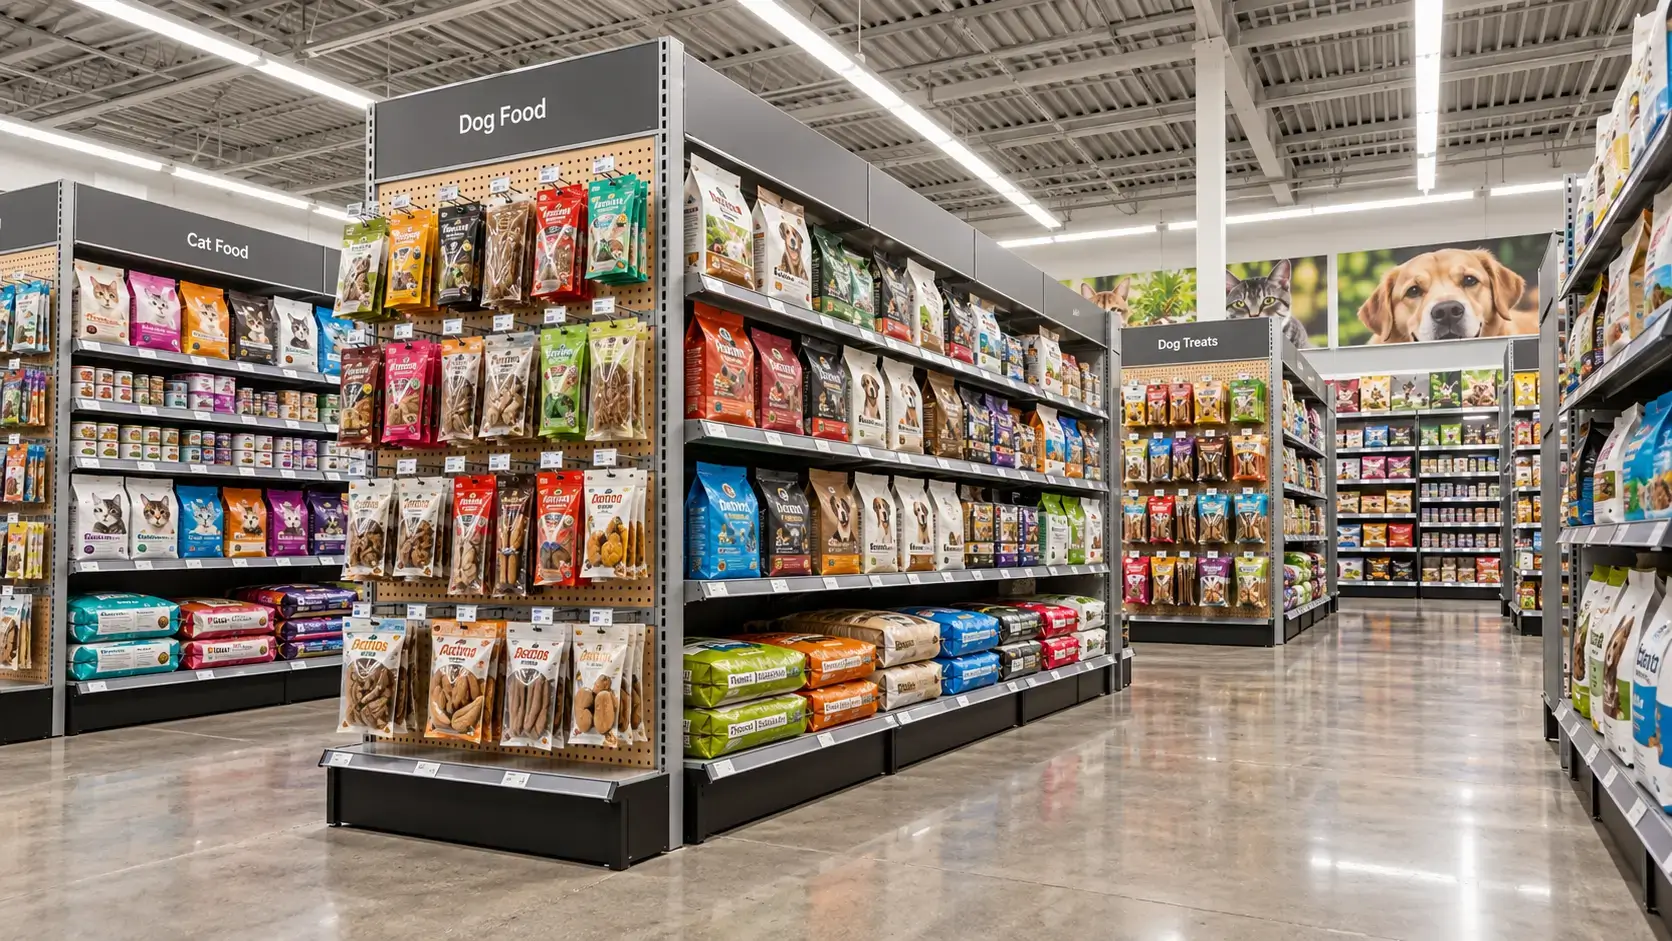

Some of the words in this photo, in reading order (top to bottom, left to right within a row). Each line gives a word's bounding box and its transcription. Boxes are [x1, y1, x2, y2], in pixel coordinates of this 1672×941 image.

[459, 113, 495, 135] Dog
[499, 97, 547, 127] Food
[186, 231, 212, 252] Cat
[215, 238, 249, 260] Food
[1157, 339, 1181, 352] Dog
[1182, 335, 1219, 349] Treats
